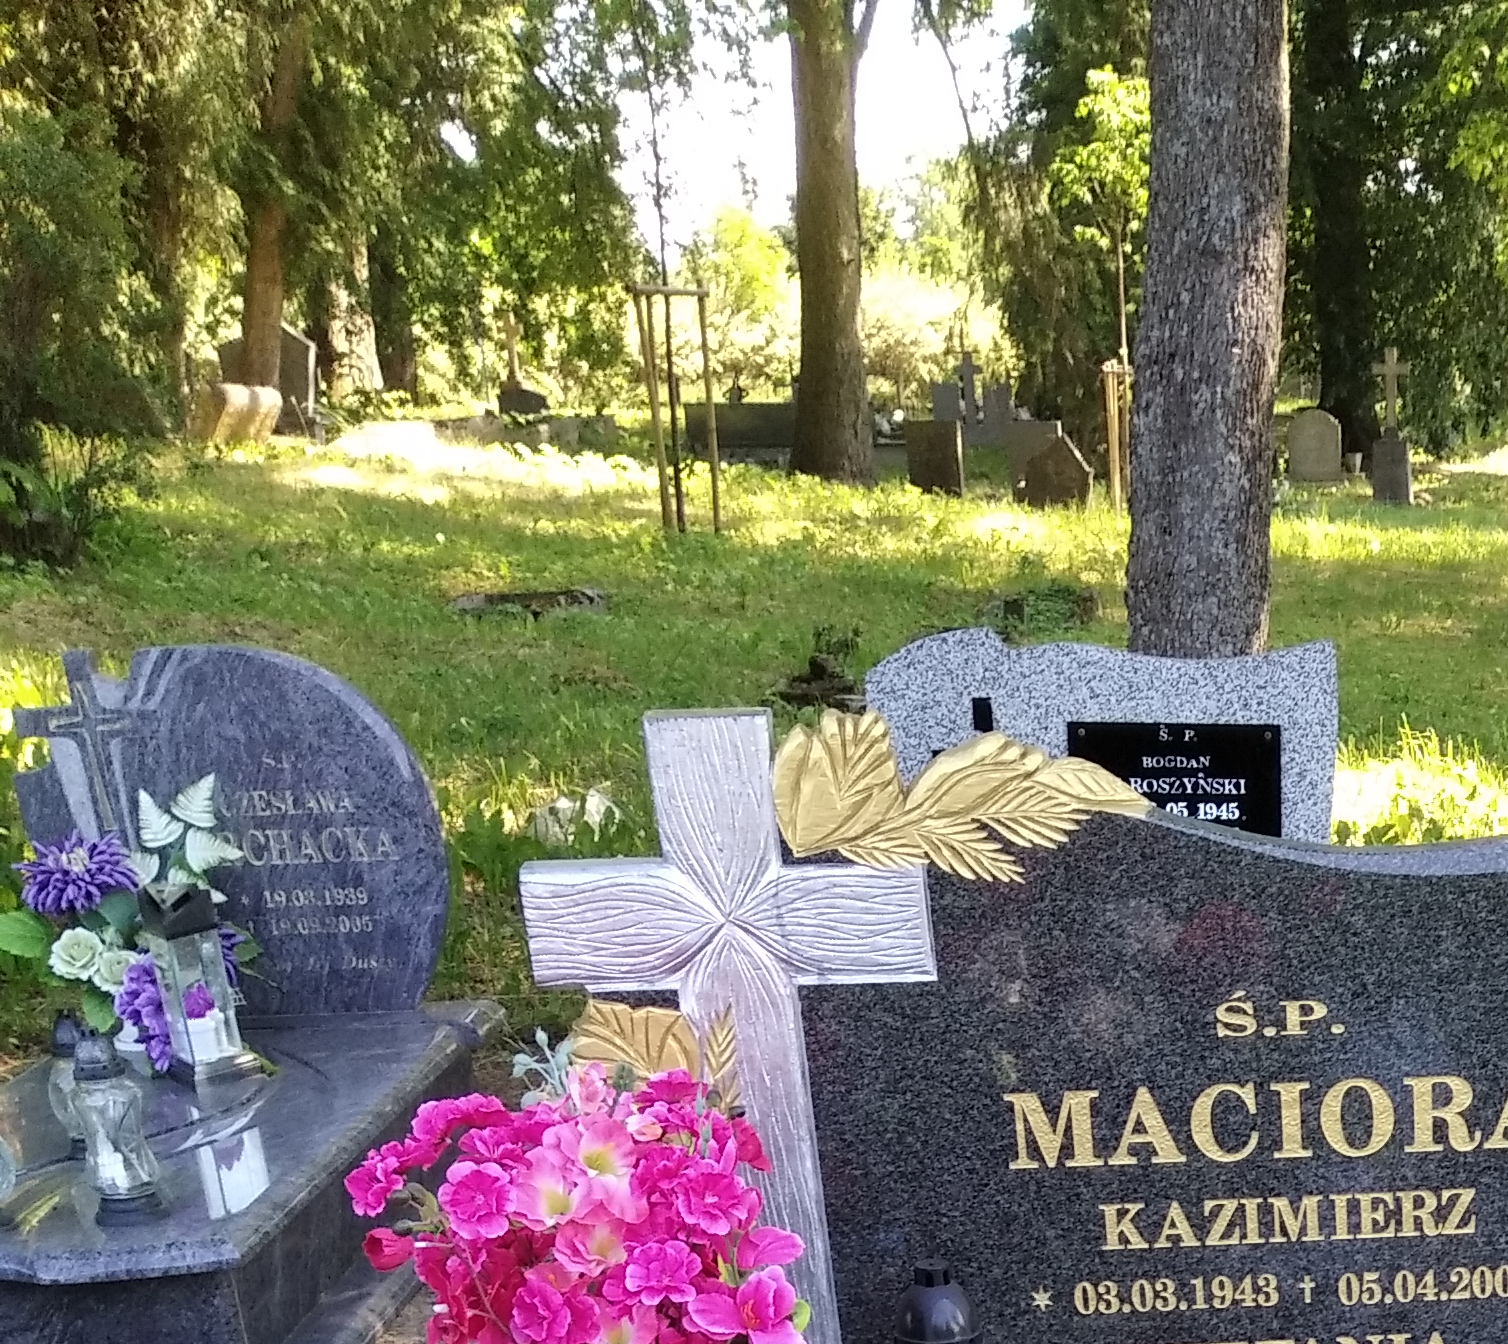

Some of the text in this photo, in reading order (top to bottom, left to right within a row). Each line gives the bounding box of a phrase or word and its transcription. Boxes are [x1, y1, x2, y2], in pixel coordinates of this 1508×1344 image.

[1129, 771, 1247, 795] ROSZYŃSKI
[1141, 755, 1211, 768] BOGDAN
[1214, 991, 1346, 1039] Ś.P.
[1098, 1187, 1477, 1252] KAZIMIERZ
[1073, 1273, 1281, 1316] 03.03.1943
